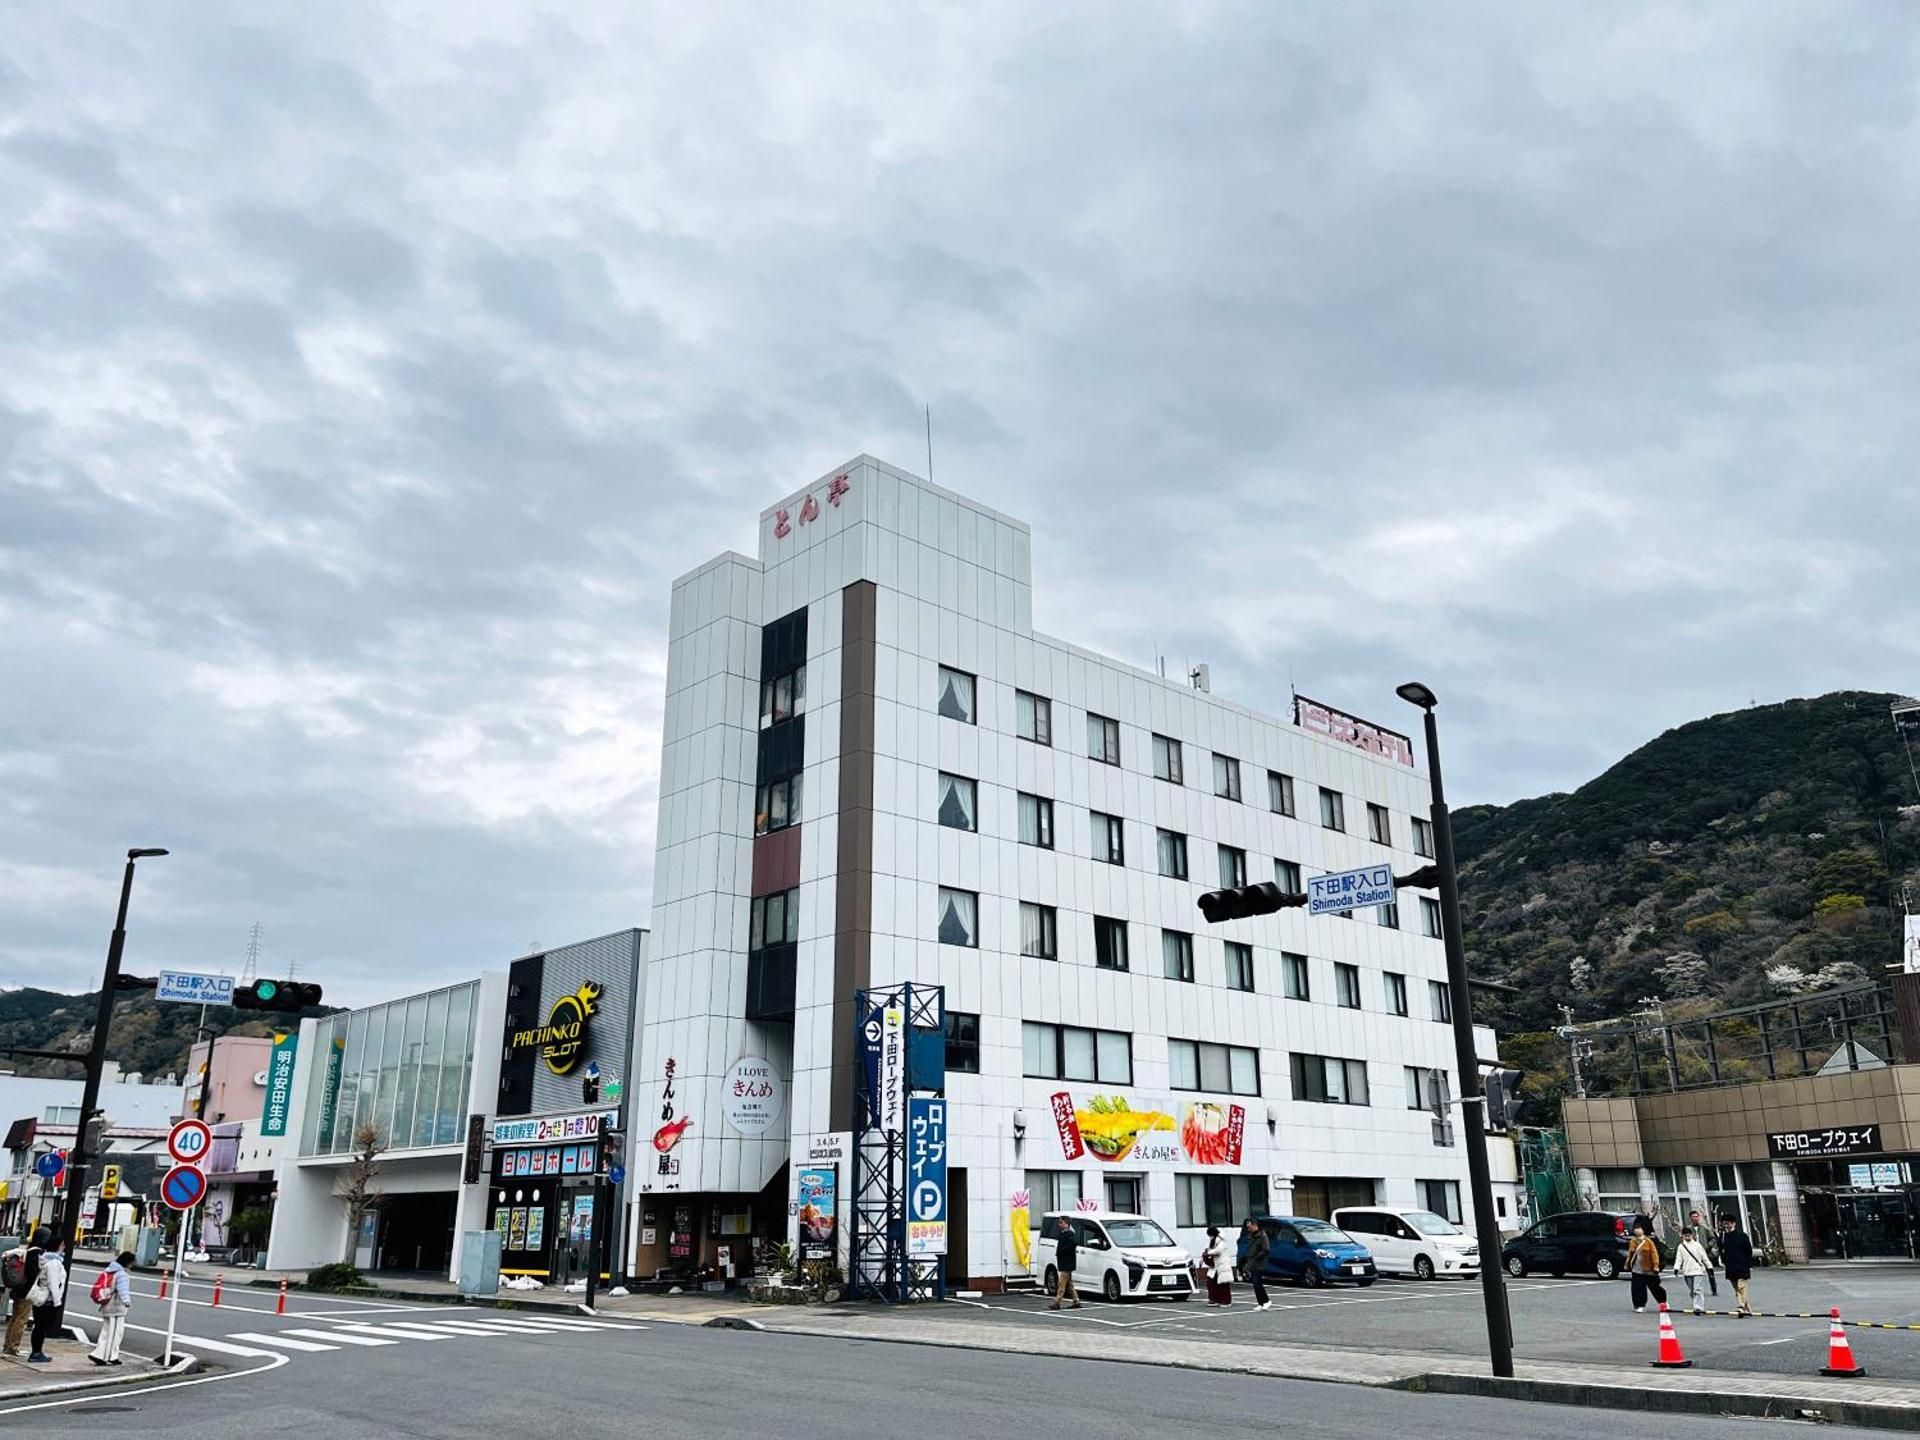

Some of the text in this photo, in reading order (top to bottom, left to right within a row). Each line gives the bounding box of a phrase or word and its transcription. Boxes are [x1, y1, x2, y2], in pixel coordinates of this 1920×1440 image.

[774, 473, 850, 540] とん亭
[1311, 870, 1388, 897] 下田駅入口
[1312, 889, 1390, 911] Shimoda Station
[160, 988, 229, 1001] Shimoda Station
[163, 974, 232, 992] 下田駅入口
[512, 1022, 581, 1048] PACHINKO
[542, 1041, 582, 1059] SLOT
[738, 1068, 769, 1077] I LOVE
[885, 1031, 898, 1124] 下田ロープウェイ
[268, 1050, 292, 1131] 明治安田生命
[733, 1079, 773, 1098] きんめ
[177, 1132, 202, 1151] 40
[928, 1104, 945, 1163] ロープ
[1772, 1127, 1873, 1151] 下田ロープウェイ
[504, 1150, 592, 1174] 日の出ホール
[1133, 1145, 1170, 1162] きんめ屋
[106, 1168, 117, 1182] P
[920, 1187, 938, 1216] P
